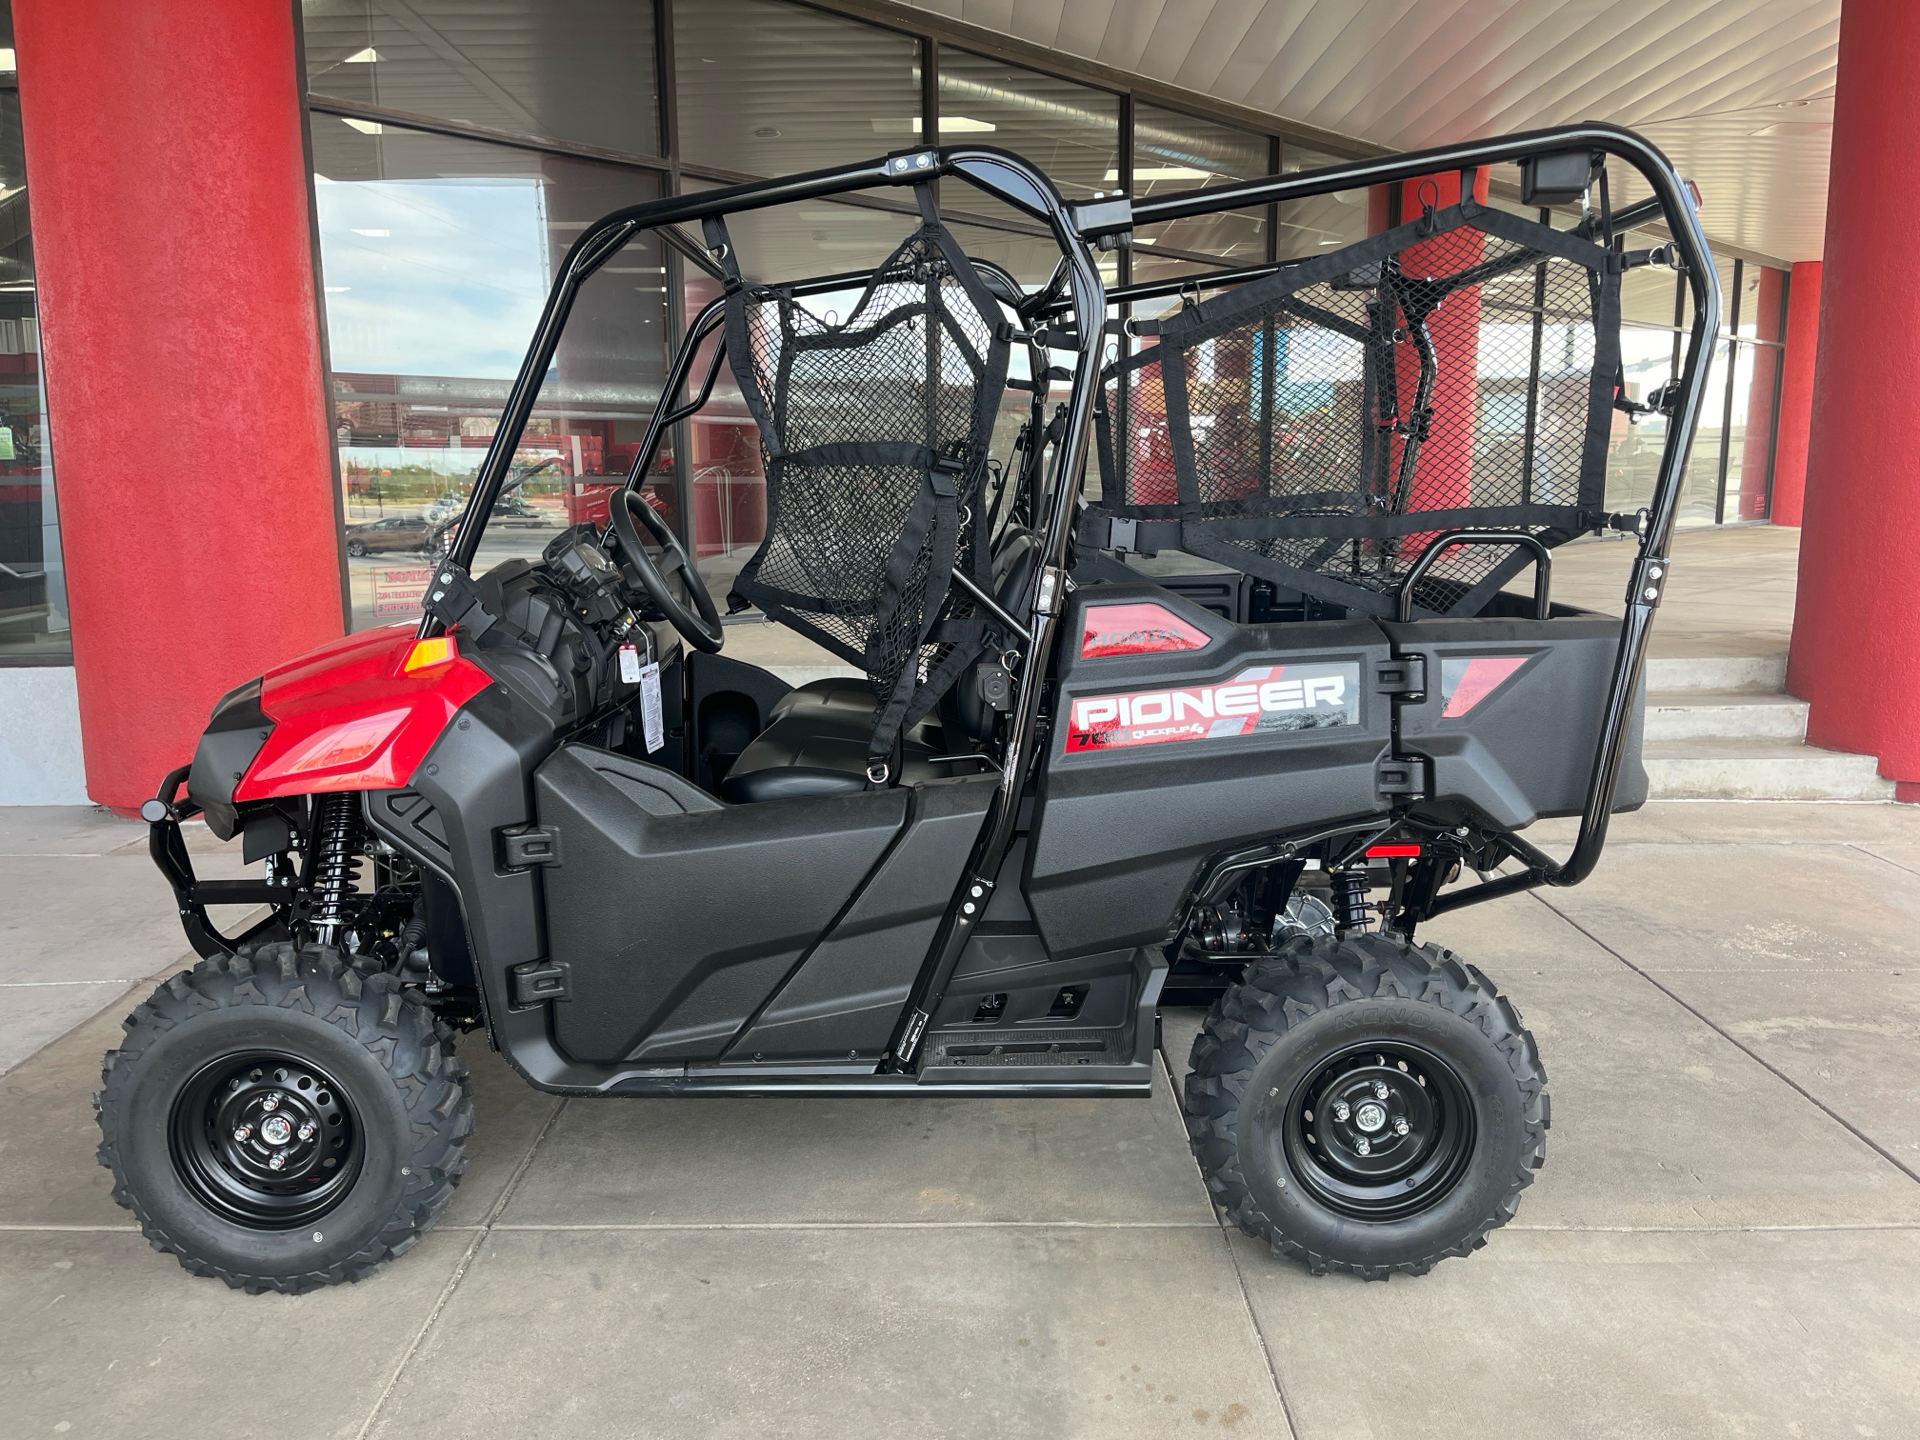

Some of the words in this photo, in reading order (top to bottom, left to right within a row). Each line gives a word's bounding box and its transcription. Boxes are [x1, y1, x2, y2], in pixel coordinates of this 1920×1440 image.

[386, 570, 435, 583] NOTIC
[1089, 628, 1184, 648] HONDA
[1076, 676, 1345, 731] PIONEER
[1072, 729, 1130, 747] 700
[1334, 1007, 1450, 1037] KENDA
